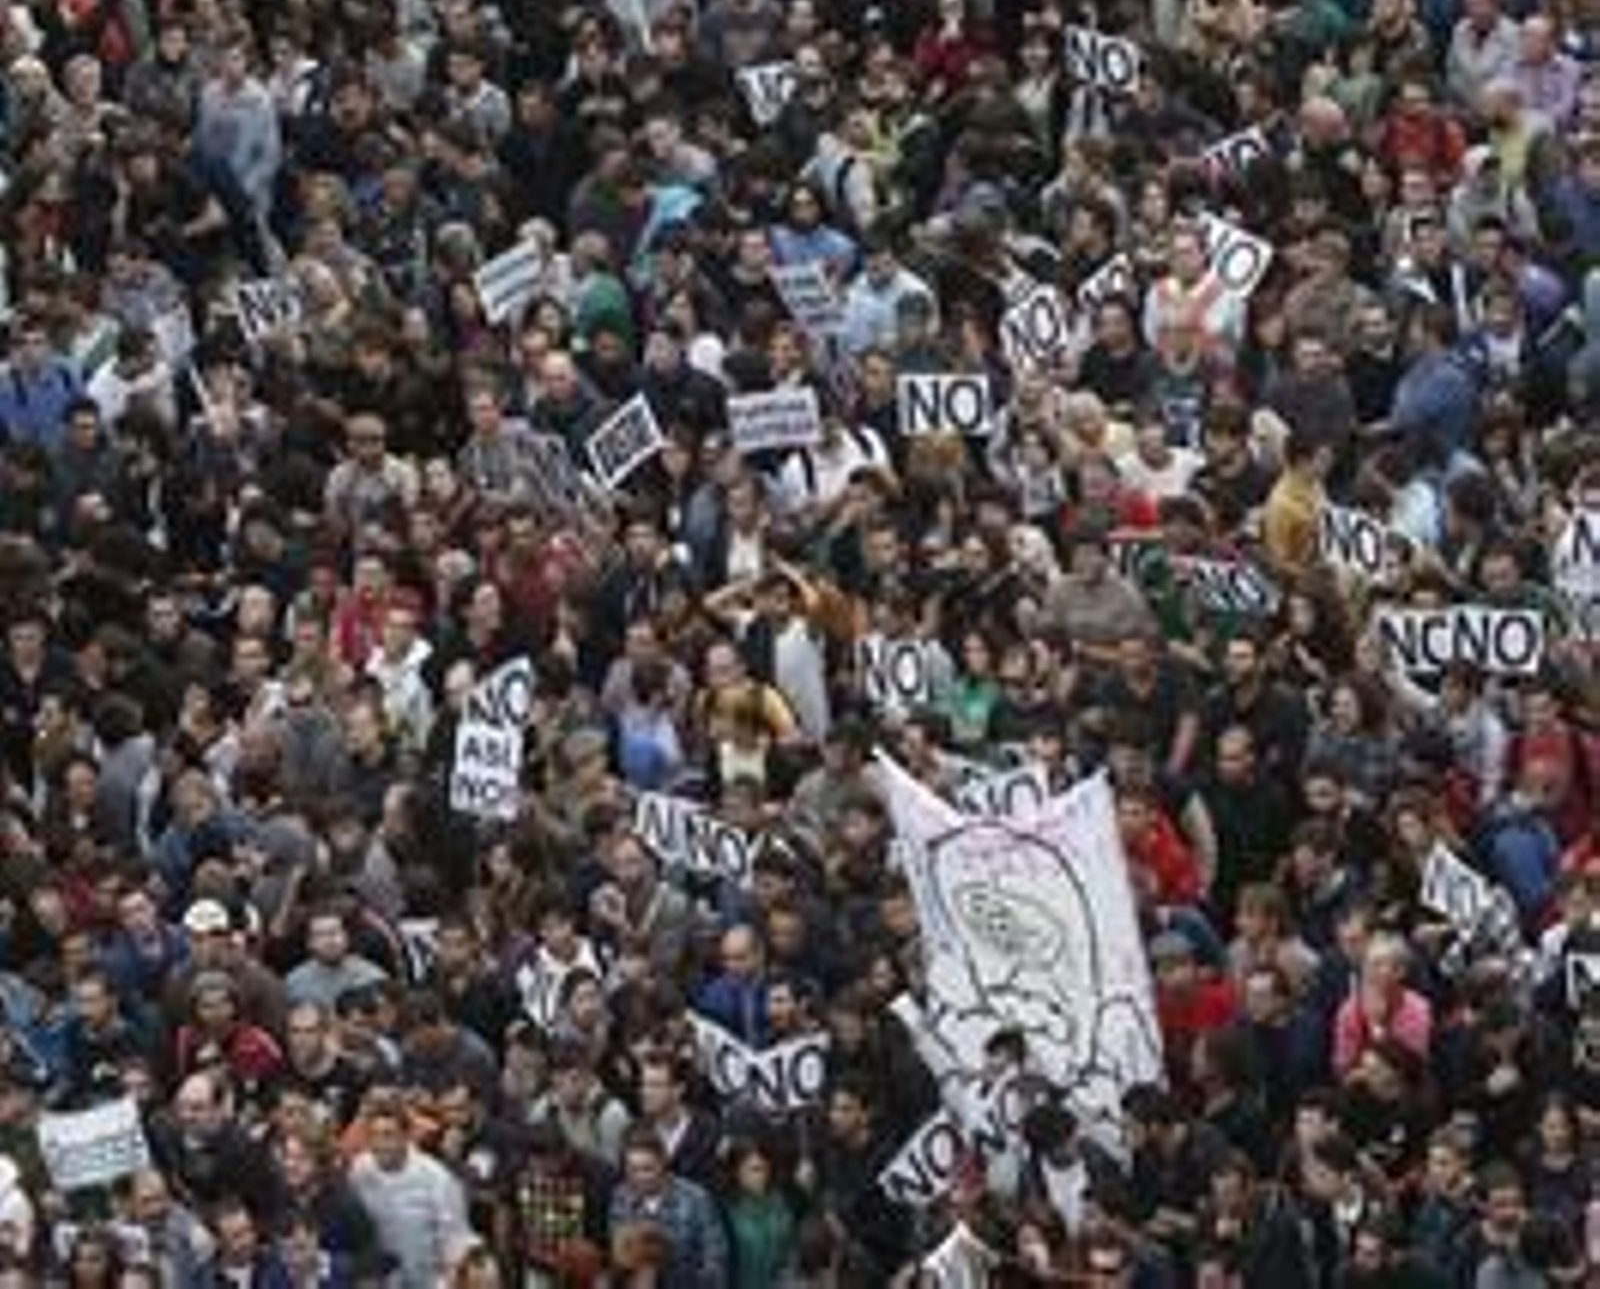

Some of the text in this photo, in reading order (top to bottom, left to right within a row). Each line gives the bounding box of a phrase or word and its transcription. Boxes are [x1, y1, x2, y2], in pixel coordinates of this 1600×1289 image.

[1065, 33, 1130, 86] NO
[905, 380, 984, 432] NO
[1319, 512, 1379, 571] NO
[1449, 611, 1539, 666] NO
[859, 642, 922, 696] NO
[748, 1044, 824, 1104] NO
[883, 1122, 964, 1205] NO
